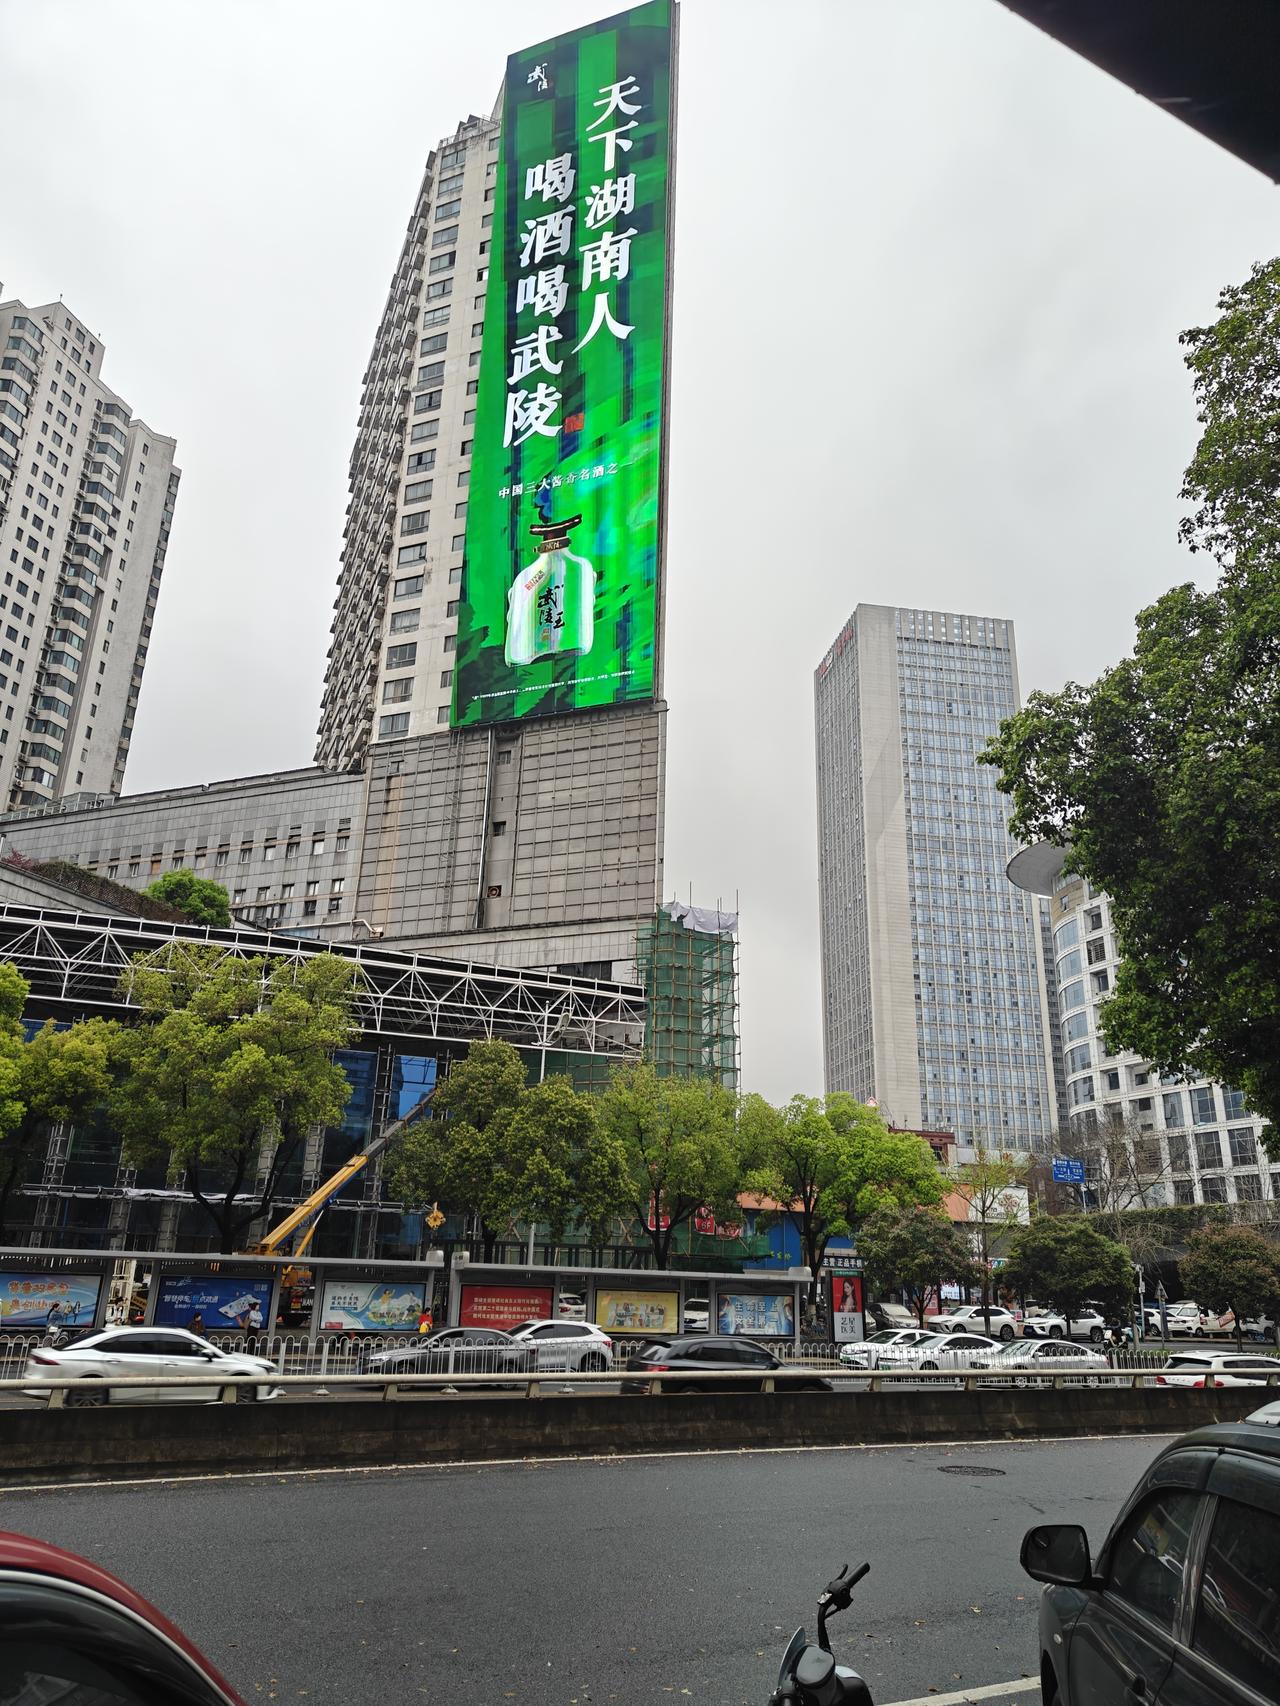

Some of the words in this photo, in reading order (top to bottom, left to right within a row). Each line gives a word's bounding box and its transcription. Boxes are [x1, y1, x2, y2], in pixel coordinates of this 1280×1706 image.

[571, 76, 642, 354] 天下湖南人
[503, 152, 576, 448] 喝酒喝武陵
[498, 461, 636, 499] 中国三大酱香名酒之一
[735, 1301, 778, 1312] 生命至上
[735, 1314, 778, 1326] 安全第一
[841, 1317, 856, 1325] 艺星
[841, 1326, 856, 1334] 医美
